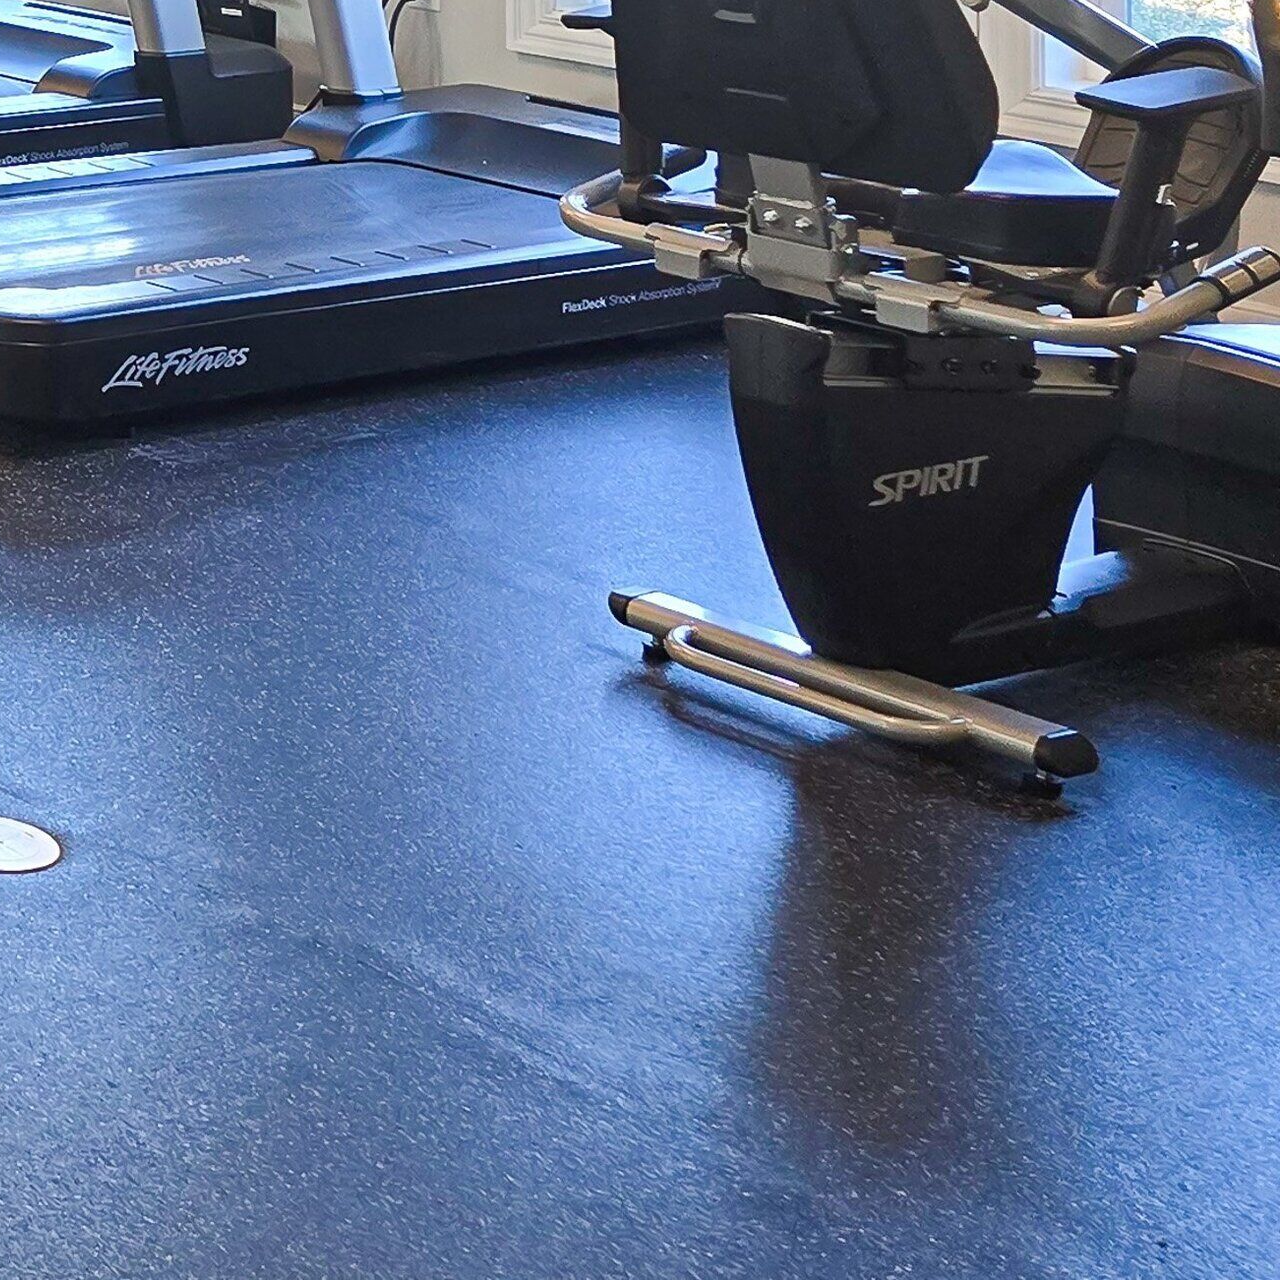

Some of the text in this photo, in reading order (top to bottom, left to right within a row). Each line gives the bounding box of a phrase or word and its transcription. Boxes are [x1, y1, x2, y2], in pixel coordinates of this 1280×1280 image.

[30, 150, 55, 163] Shock
[57, 145, 99, 160] Absorption
[609, 293, 636, 307] Shock
[638, 286, 685, 302] Absorption
[868, 455, 989, 507] SPIRIT
